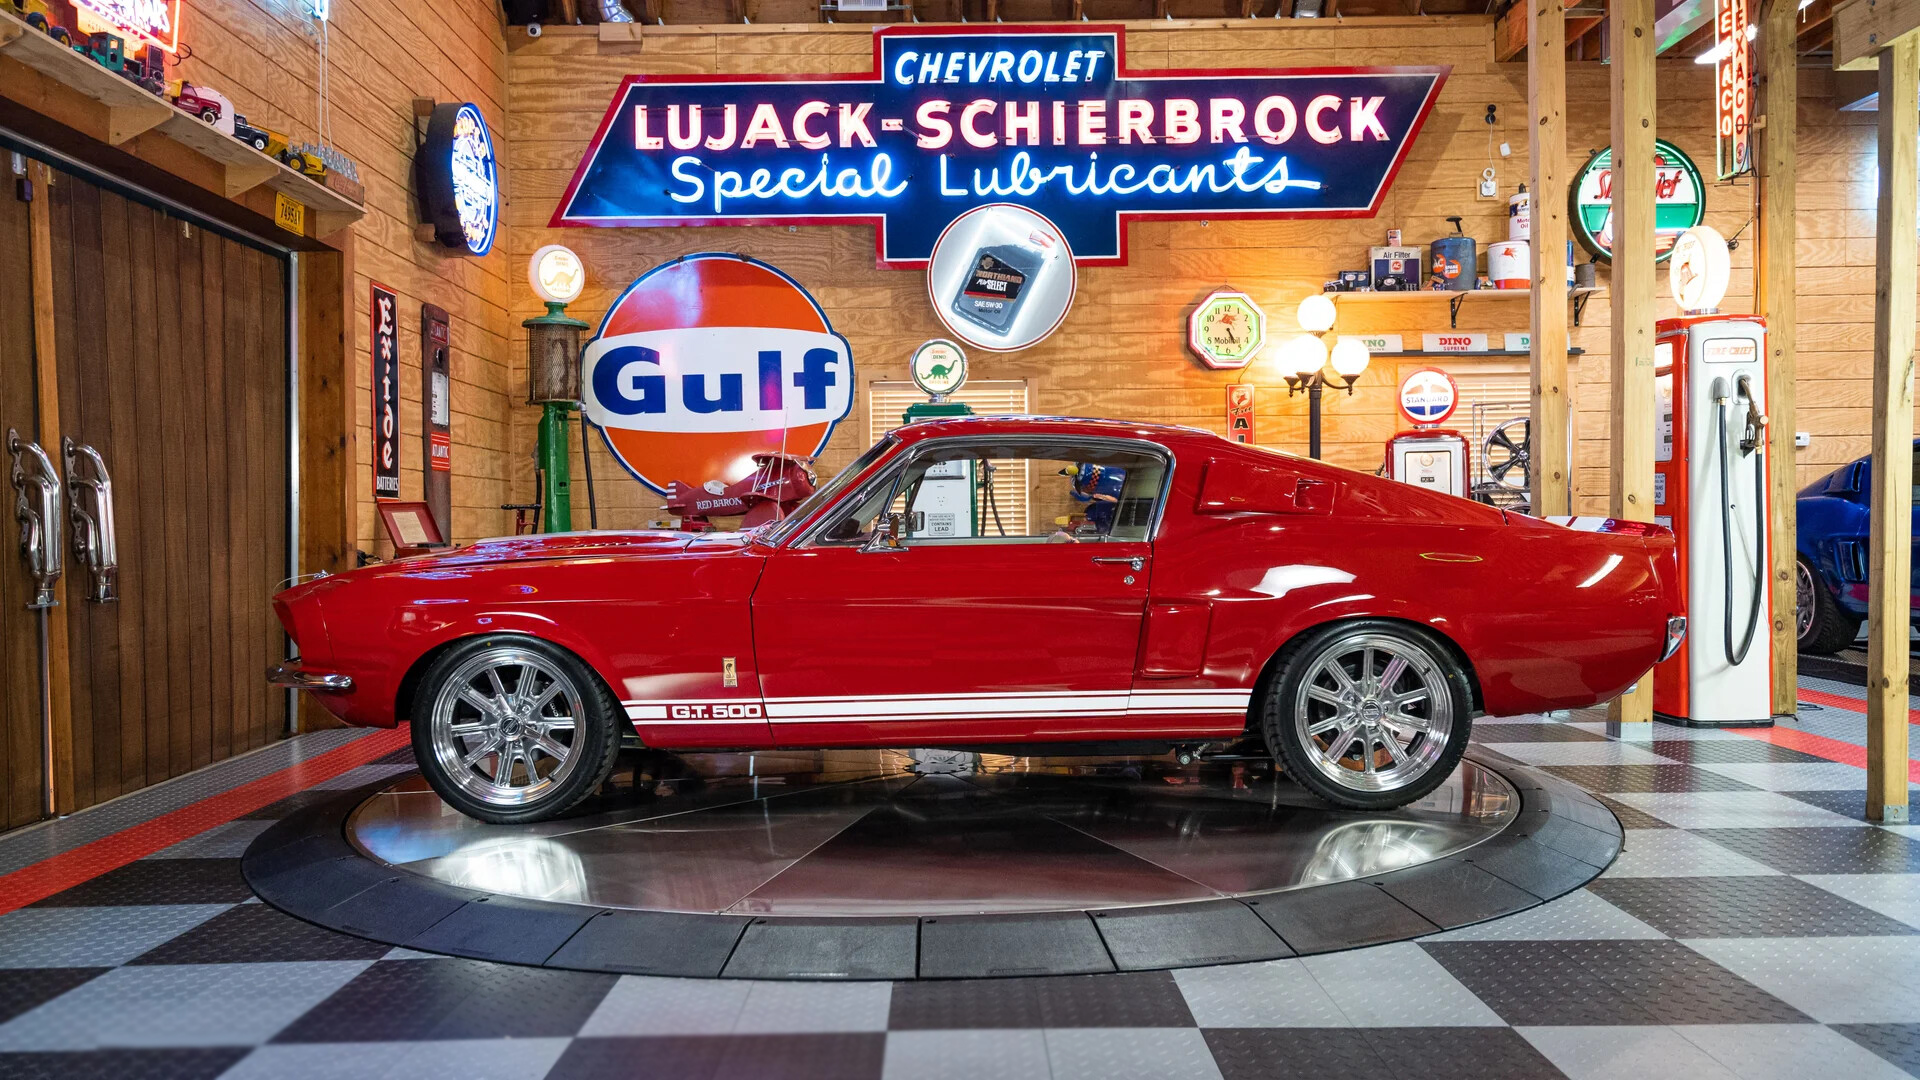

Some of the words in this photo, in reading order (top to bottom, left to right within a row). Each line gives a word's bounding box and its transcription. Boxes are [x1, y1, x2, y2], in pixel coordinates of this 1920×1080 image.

[894, 50, 1106, 85] CHEVROLET
[1721, 0, 1733, 136] EACO
[634, 94, 1391, 149] LUJACK-SCHIERBROCK
[670, 152, 909, 213] Special
[940, 146, 1322, 196] Lubricants
[1655, 169, 1682, 199] ief
[976, 270, 1022, 283] NORTHLAND
[974, 300, 986, 308] SAE
[1439, 337, 1472, 346] DINO
[378, 297, 394, 469] Exide
[592, 345, 838, 415] Gulf
[376, 476, 398, 491] BATTERIES
[696, 500, 712, 510] RED
[713, 497, 742, 508] BARON
[671, 705, 709, 719] G.T.
[712, 704, 762, 719] 500
